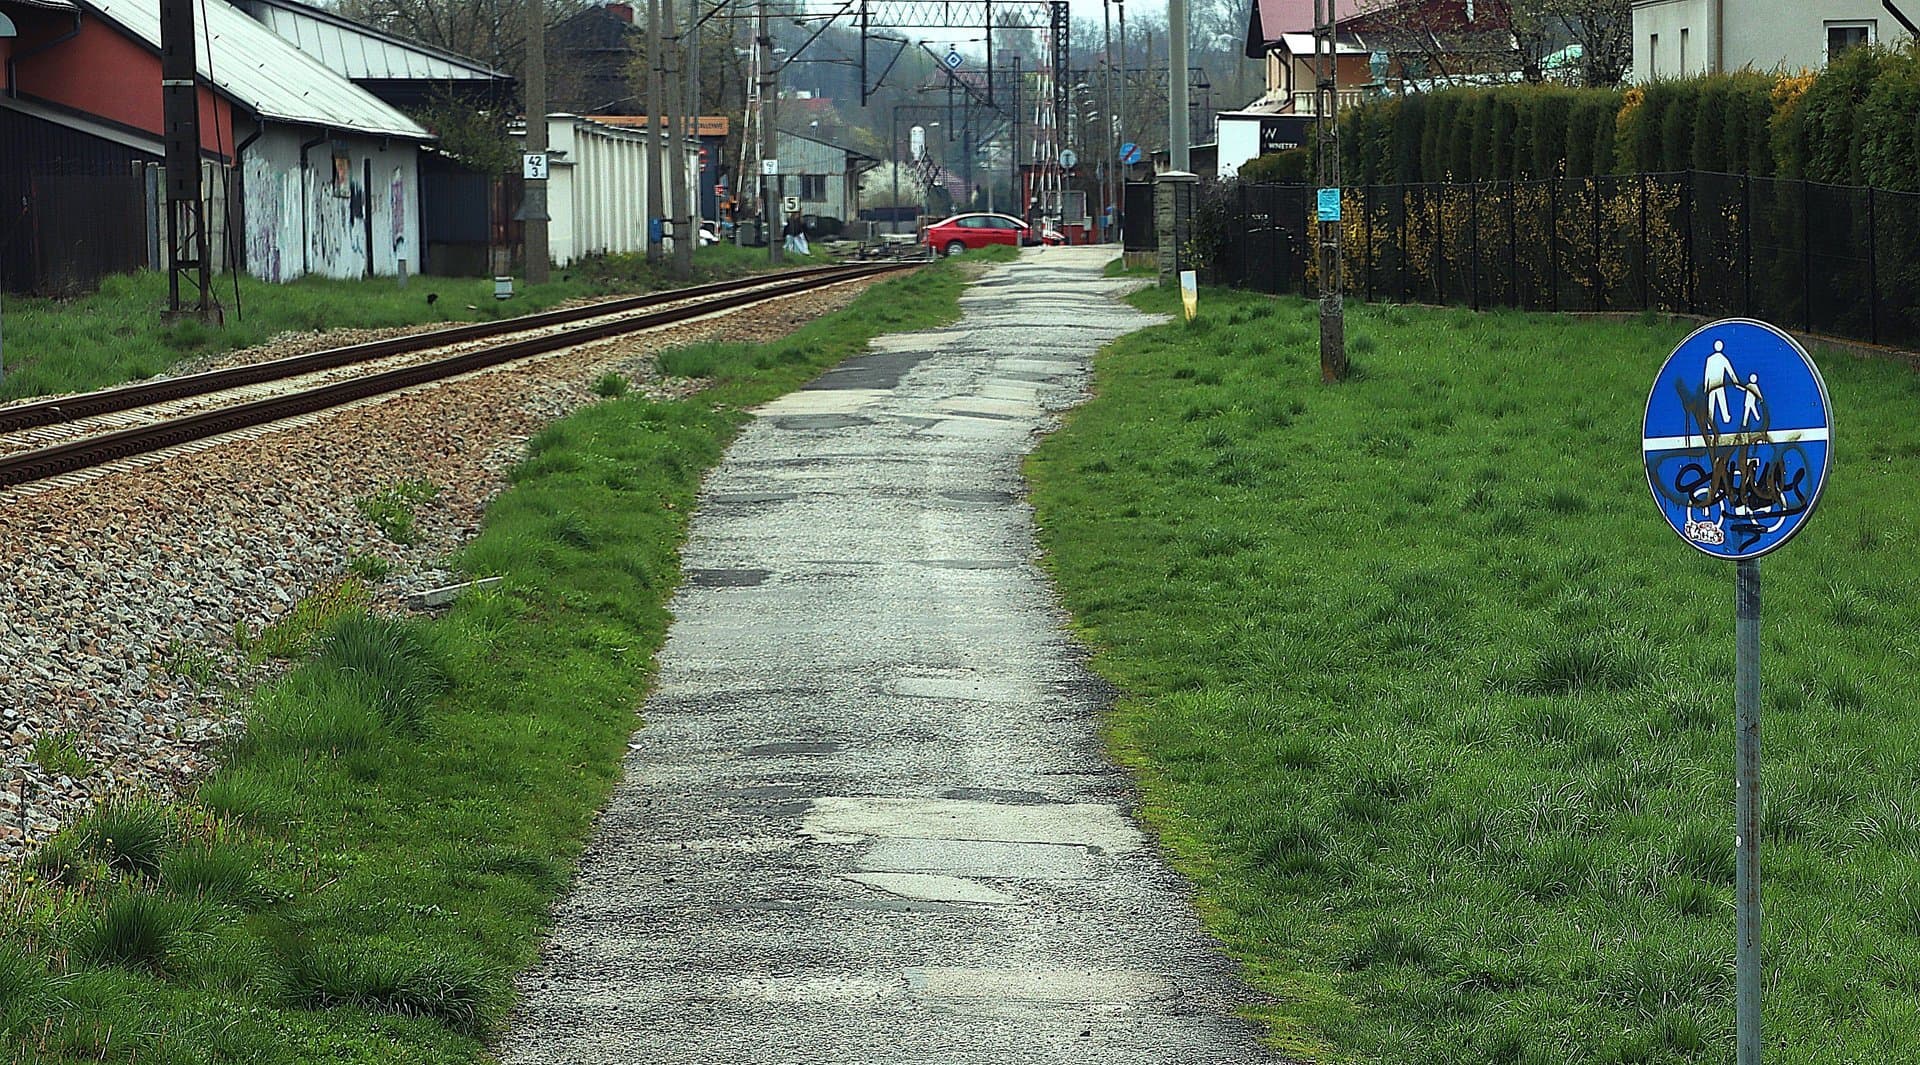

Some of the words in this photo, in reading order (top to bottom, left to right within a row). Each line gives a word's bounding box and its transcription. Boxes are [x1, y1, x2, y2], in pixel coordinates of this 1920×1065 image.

[528, 155, 542, 167] 42
[531, 166, 539, 178] 3
[786, 197, 797, 210] 5
